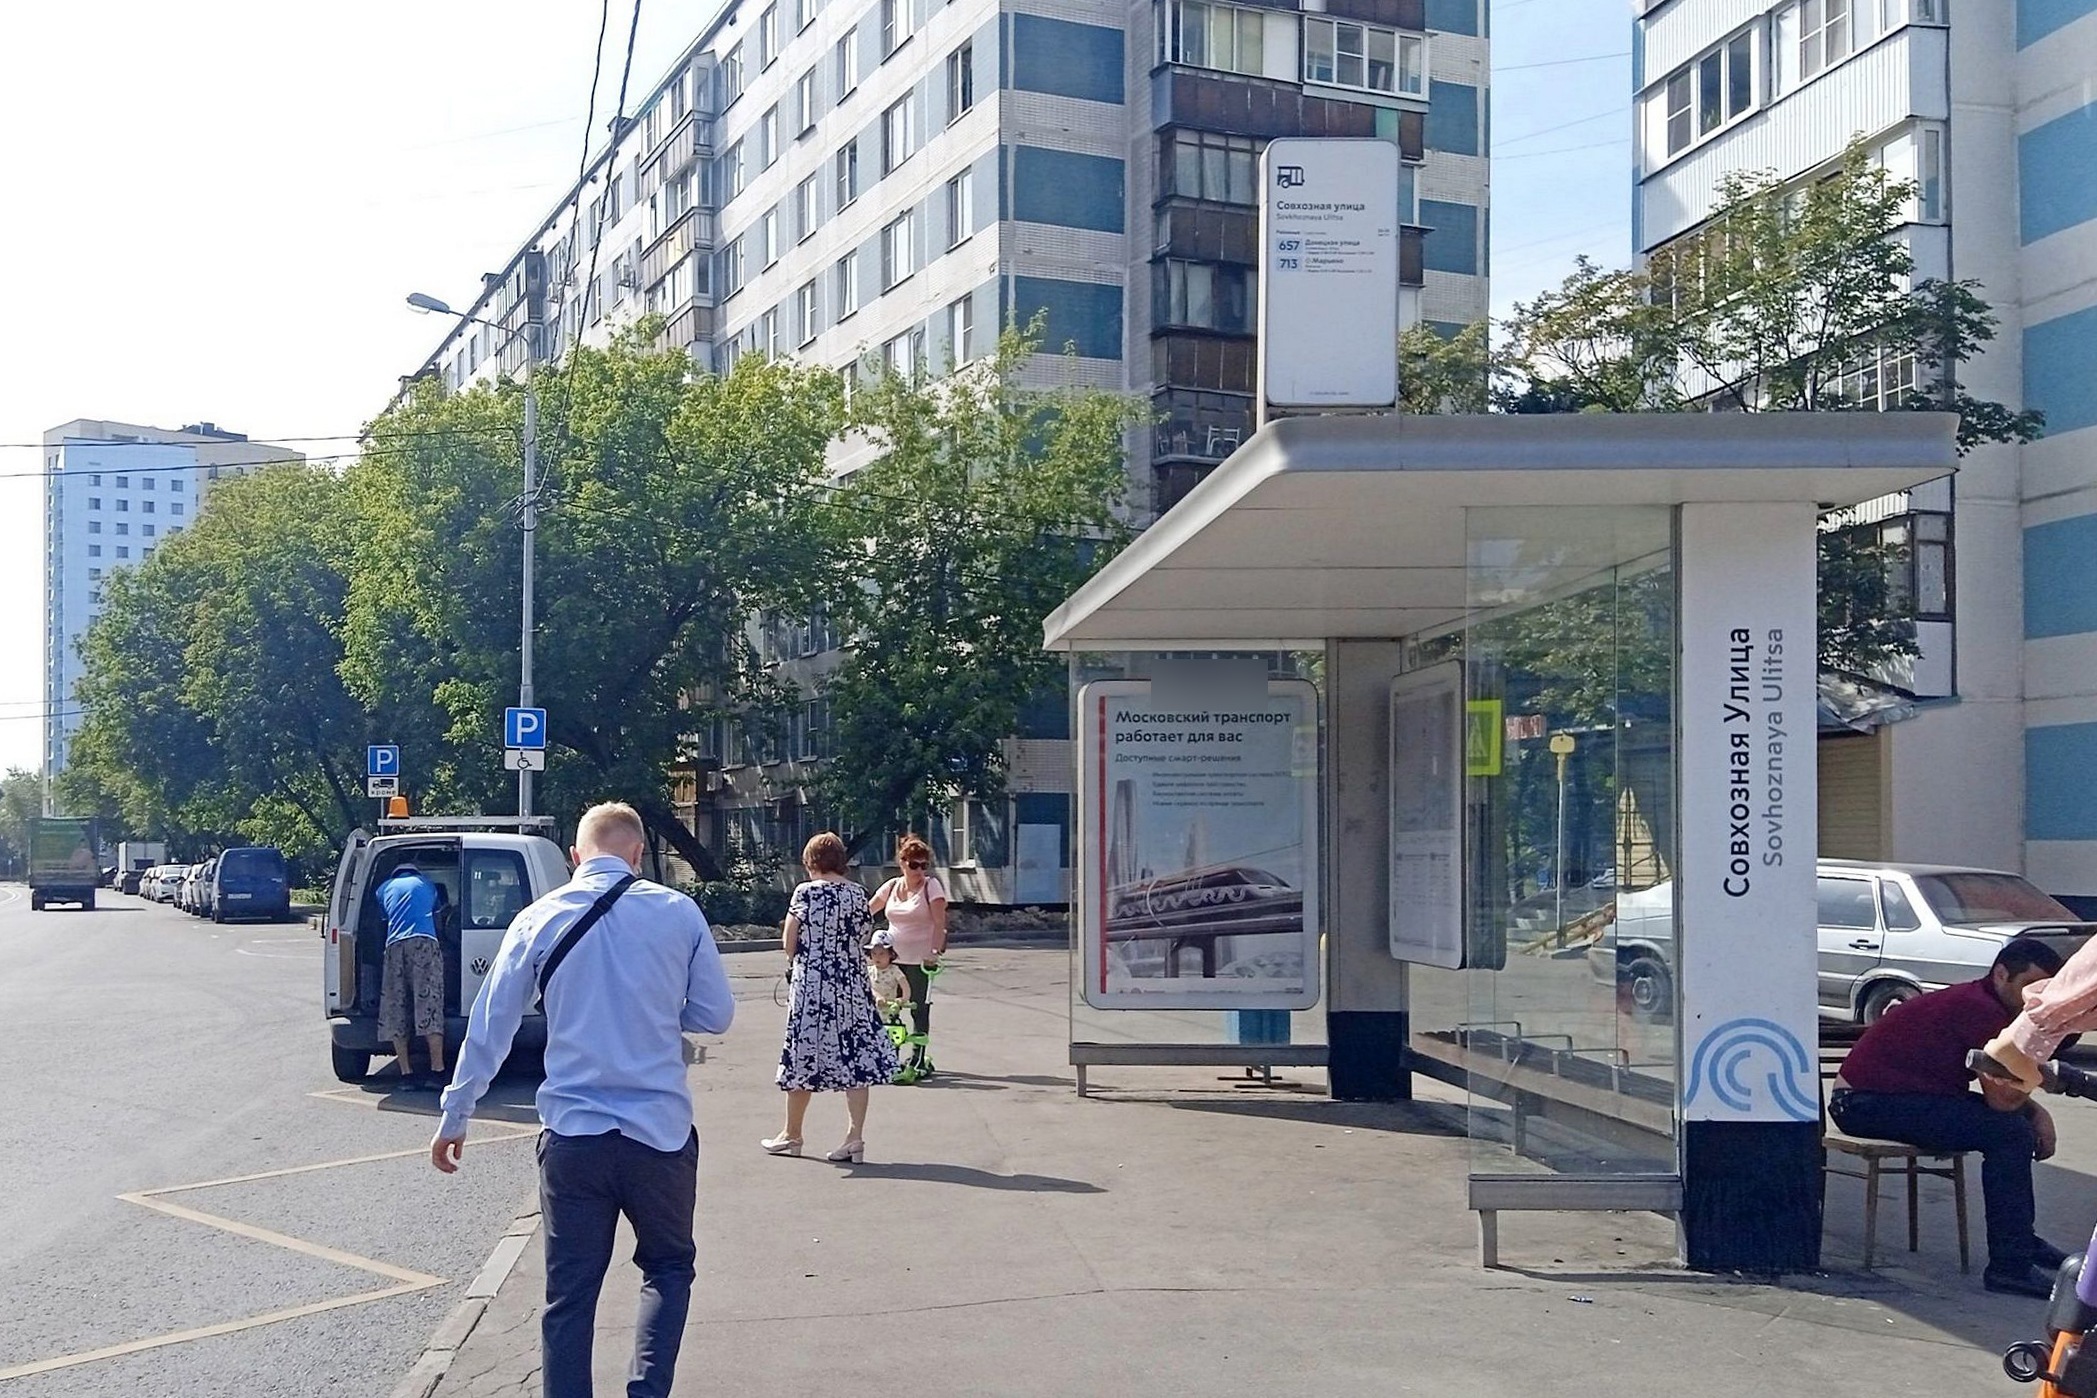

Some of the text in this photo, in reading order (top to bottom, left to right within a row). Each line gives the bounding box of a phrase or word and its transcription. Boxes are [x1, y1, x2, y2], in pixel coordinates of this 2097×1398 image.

[1276, 200, 1365, 213] Совхозная улица
[1278, 240, 1301, 251] 657
[1280, 258, 1298, 269] 713
[1115, 710, 1292, 726] Московский транспорт
[1115, 729, 1243, 745] работает для вас
[1761, 627, 1788, 867] Sovhoznaya Ulitsa
[1115, 753, 1242, 764] Доступные смарт-решения
[1723, 627, 1754, 898] Совхозная Улица
